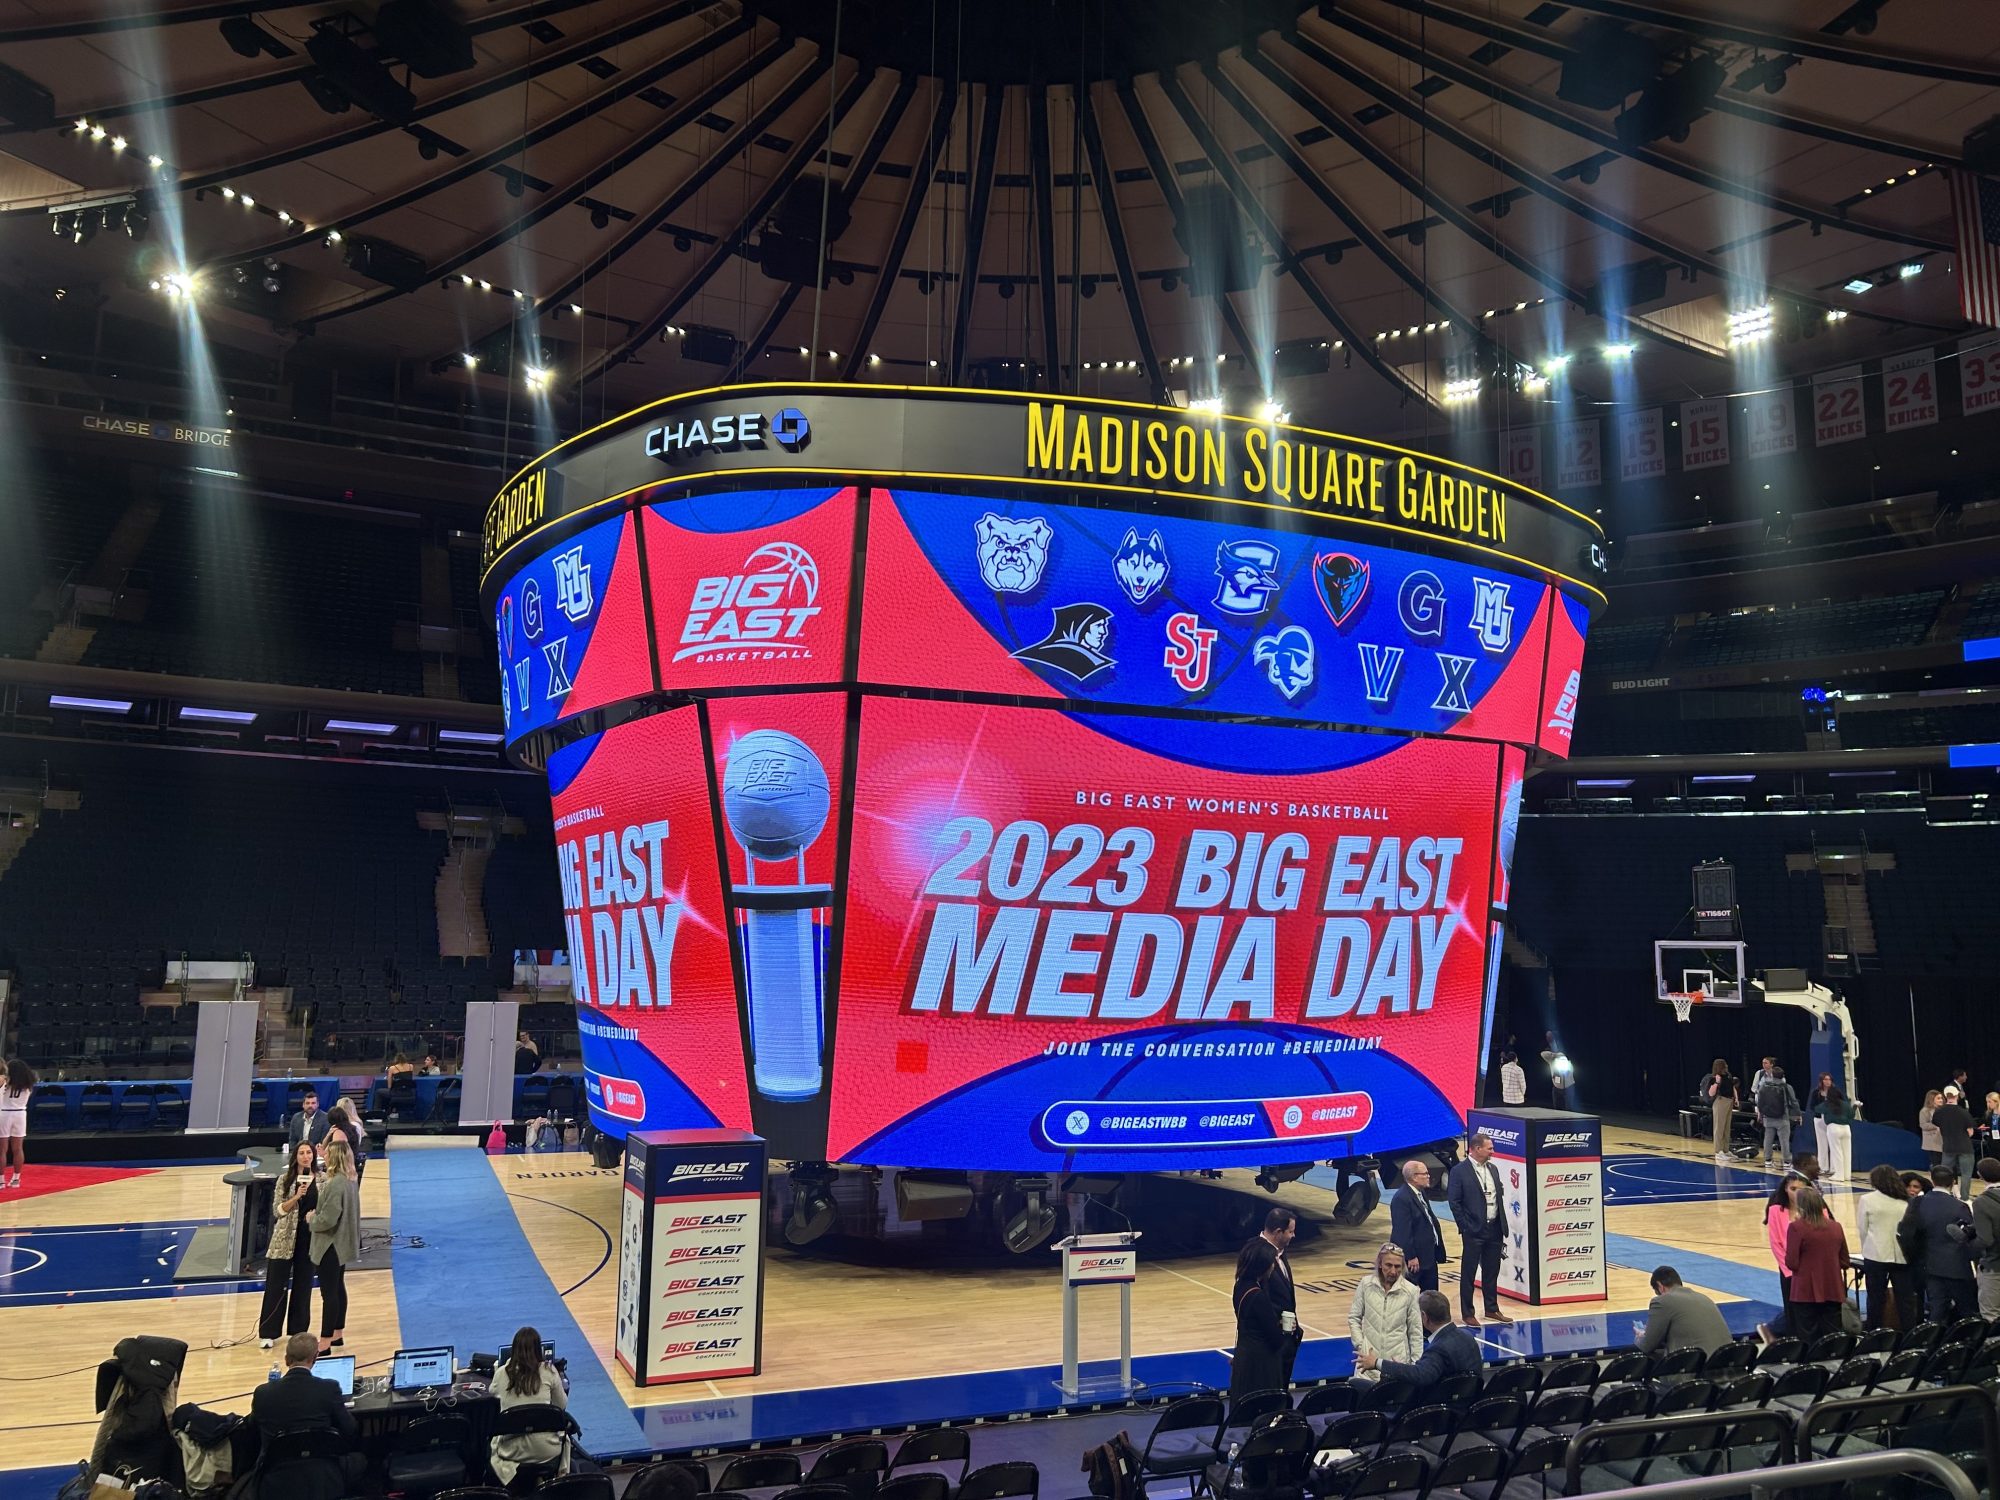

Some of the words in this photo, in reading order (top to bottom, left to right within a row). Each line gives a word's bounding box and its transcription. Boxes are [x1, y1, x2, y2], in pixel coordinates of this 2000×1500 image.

[1888, 371, 1932, 407] 24
[1755, 403, 1787, 435] 19
[1817, 388, 1860, 422] 22
[1888, 405, 1936, 426] KNICKS
[83, 415, 150, 436] CHASE
[174, 428, 231, 447] BRIDGE
[644, 413, 762, 458] CHASE
[1627, 428, 1657, 459] 15
[1689, 417, 1720, 448] 15
[1817, 421, 1863, 441] KNICKS
[1565, 440, 1594, 467] 12
[1623, 458, 1664, 477] KNICKS
[1685, 448, 1727, 466] KNICKS
[1559, 469, 1600, 485] KNICKS
[689, 572, 790, 613] BIG
[1398, 568, 1447, 637] G
[520, 577, 544, 640] G
[679, 605, 823, 644] EAST
[542, 635, 573, 700] X
[695, 650, 814, 665] BASKETBALL
[1358, 642, 1404, 702] V
[1431, 651, 1478, 714] X
[1612, 679, 1635, 690] BUD
[1637, 677, 1671, 689] LIGHT
[744, 771, 798, 785] EAST
[567, 805, 605, 827] BASKETBALL
[1075, 790, 1113, 807] BIG
[1123, 793, 1176, 811] EAST
[1185, 796, 1280, 816] WOMEN'S
[1287, 802, 1390, 822] BASKETBALL
[585, 819, 670, 908] EAST
[924, 815, 1156, 908] 2023
[1174, 827, 1311, 911] BIG
[1322, 835, 1464, 911] EAST
[592, 902, 684, 1007] DAY
[910, 902, 1276, 1020] MEDIA
[1305, 912, 1464, 1019] DAY
[1043, 1040, 1091, 1057] JOIN
[1101, 1043, 1135, 1057] THE
[1144, 1042, 1276, 1058] CONVERSATION
[1282, 1035, 1383, 1055] #BEMEDIADAY
[1100, 1116, 1188, 1130] @BIGEASTWBB
[1199, 1113, 1256, 1129] @BIGEAST
[1311, 1105, 1358, 1122] @BIGEAST
[696, 1320, 738, 1328] CONFERENCE
[695, 1352, 737, 1360] CONFERENCE
